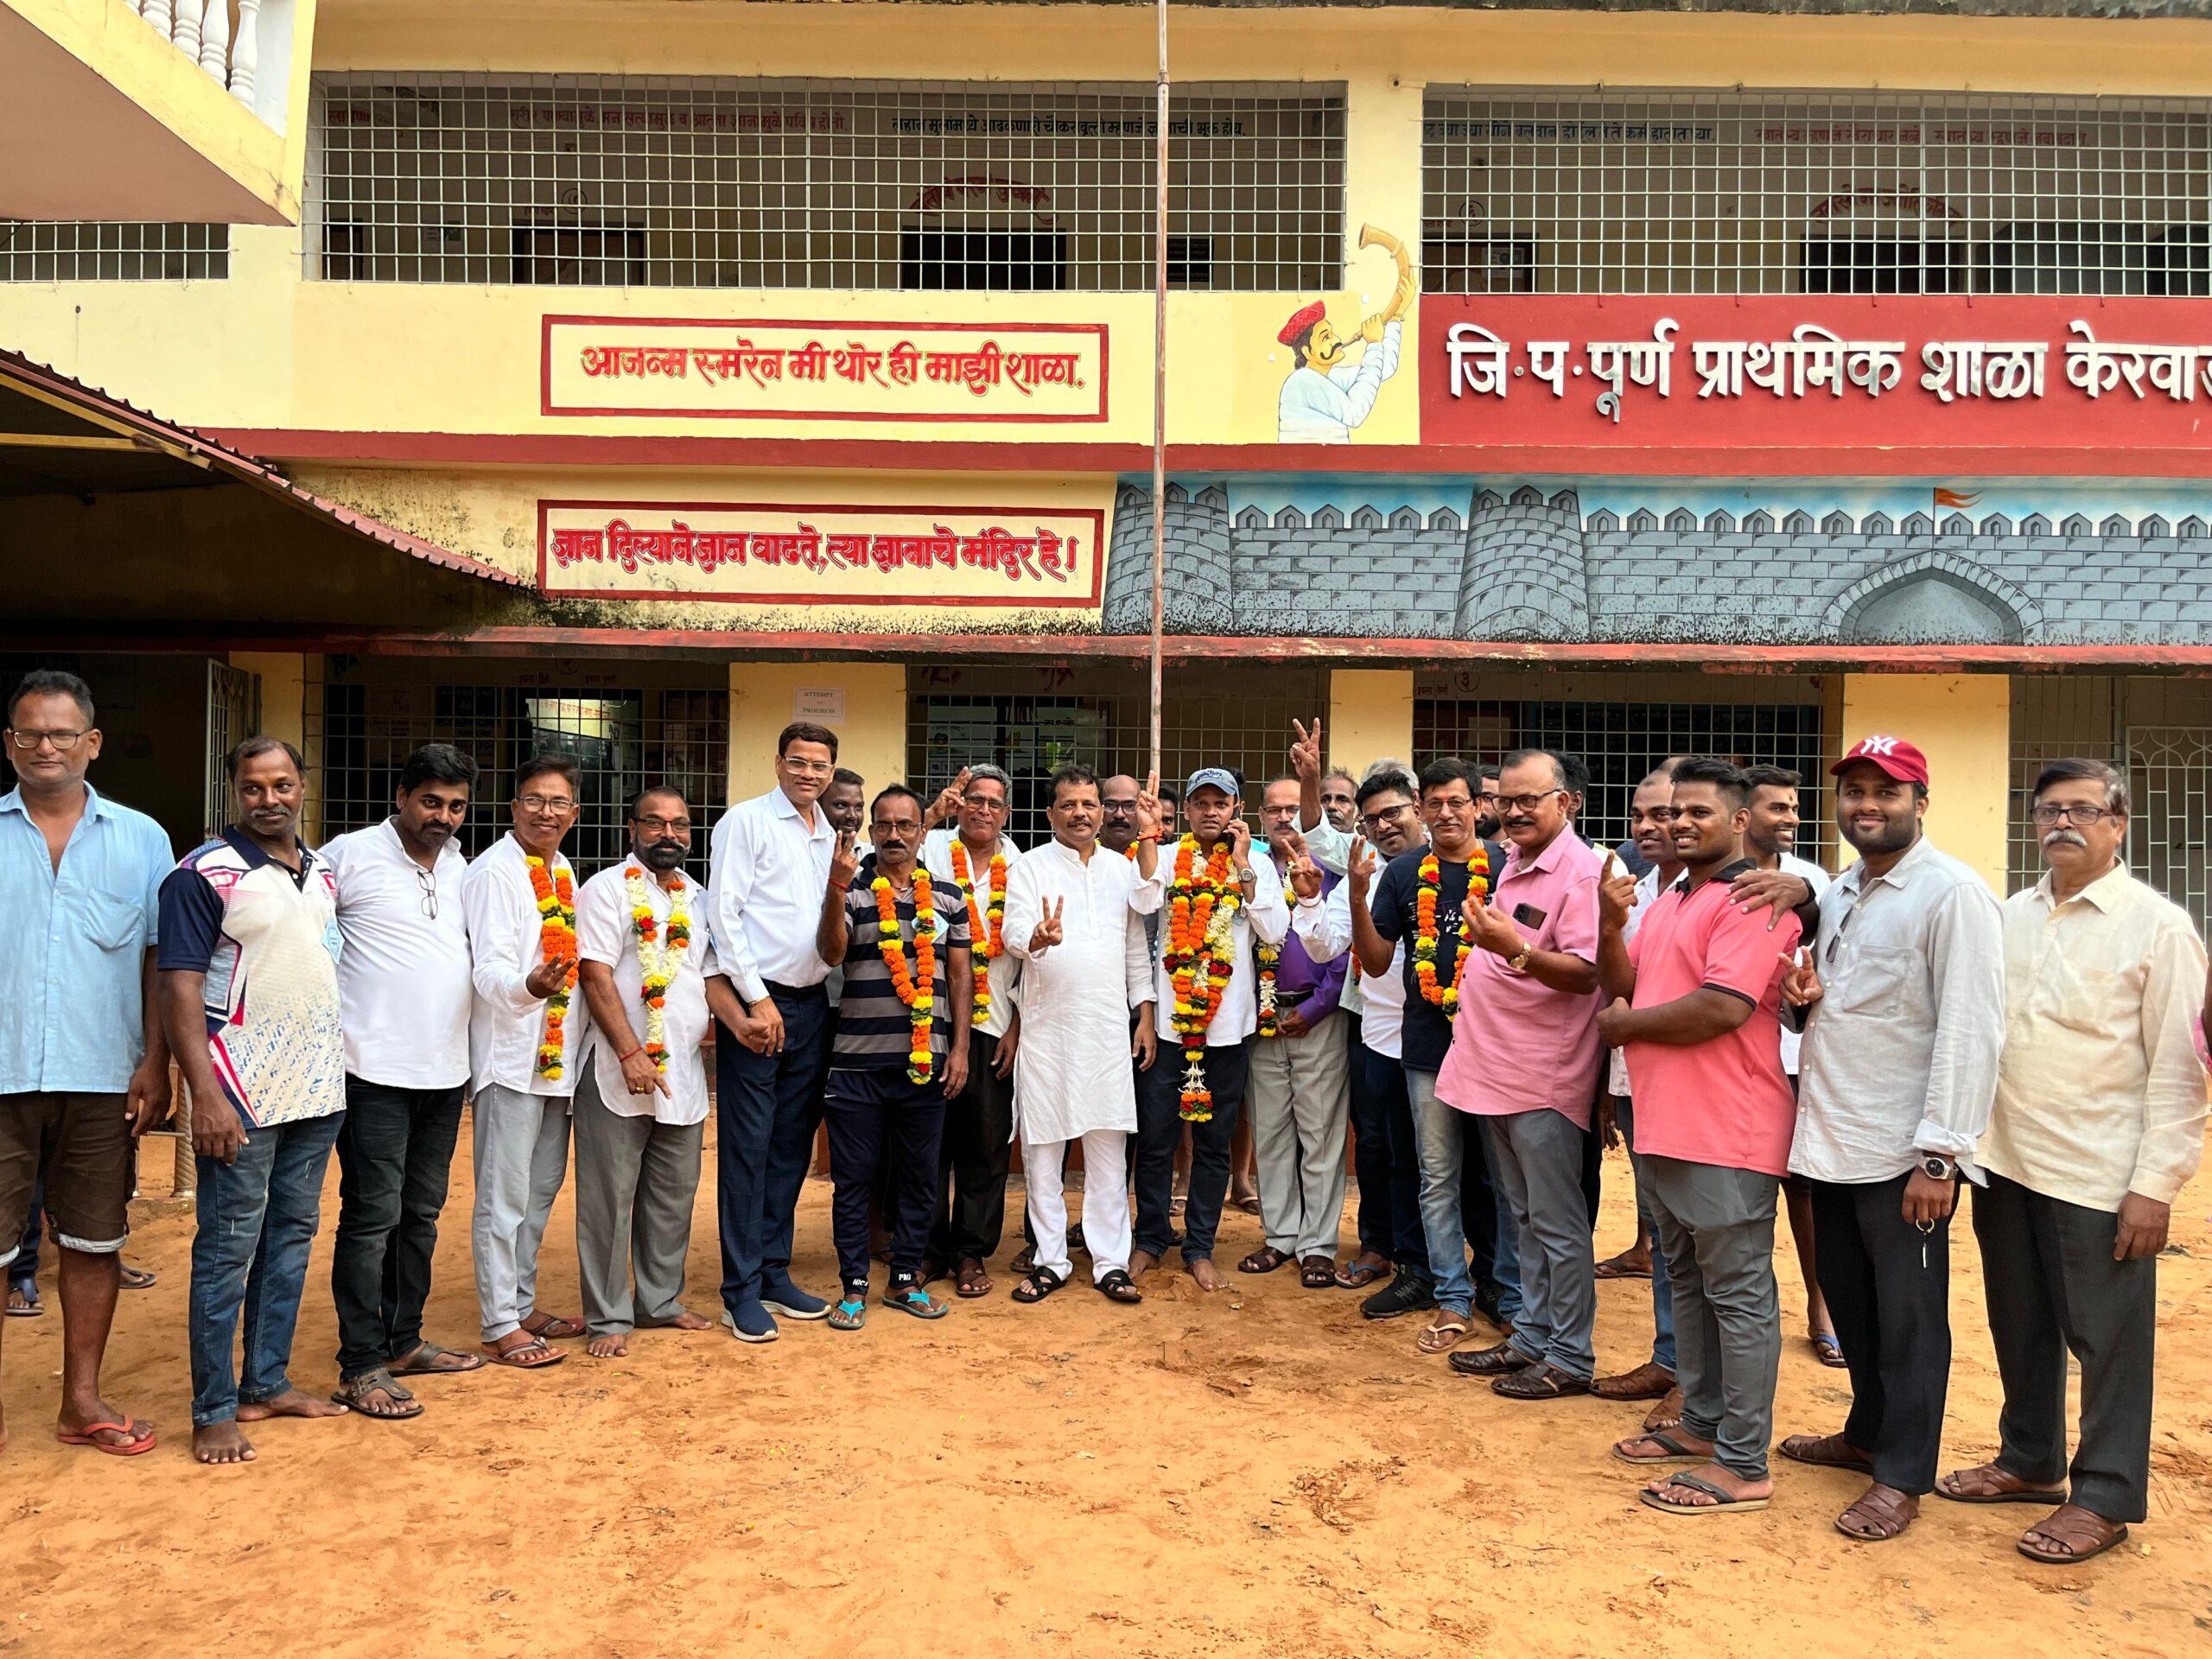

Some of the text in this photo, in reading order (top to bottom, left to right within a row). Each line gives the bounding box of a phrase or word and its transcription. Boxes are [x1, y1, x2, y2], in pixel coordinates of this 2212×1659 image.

[580, 346, 689, 380] आजन्म
[690, 334, 787, 391] स्मरेन
[788, 339, 831, 383] मी
[832, 339, 891, 390] थोर
[887, 338, 922, 387] ही
[924, 339, 1006, 397] माझी
[1692, 323, 1906, 400] प्राथमिक
[1919, 340, 2050, 404] शाळा
[550, 528, 604, 569] ज्ञान
[605, 518, 696, 574] दिल्याने
[693, 531, 751, 574] ज्ञान
[825, 533, 873, 570] त्या
[870, 522, 962, 574] ज्ञानाचे
[960, 526, 1042, 581] मंदिर
[1859, 735, 1899, 757] NY
